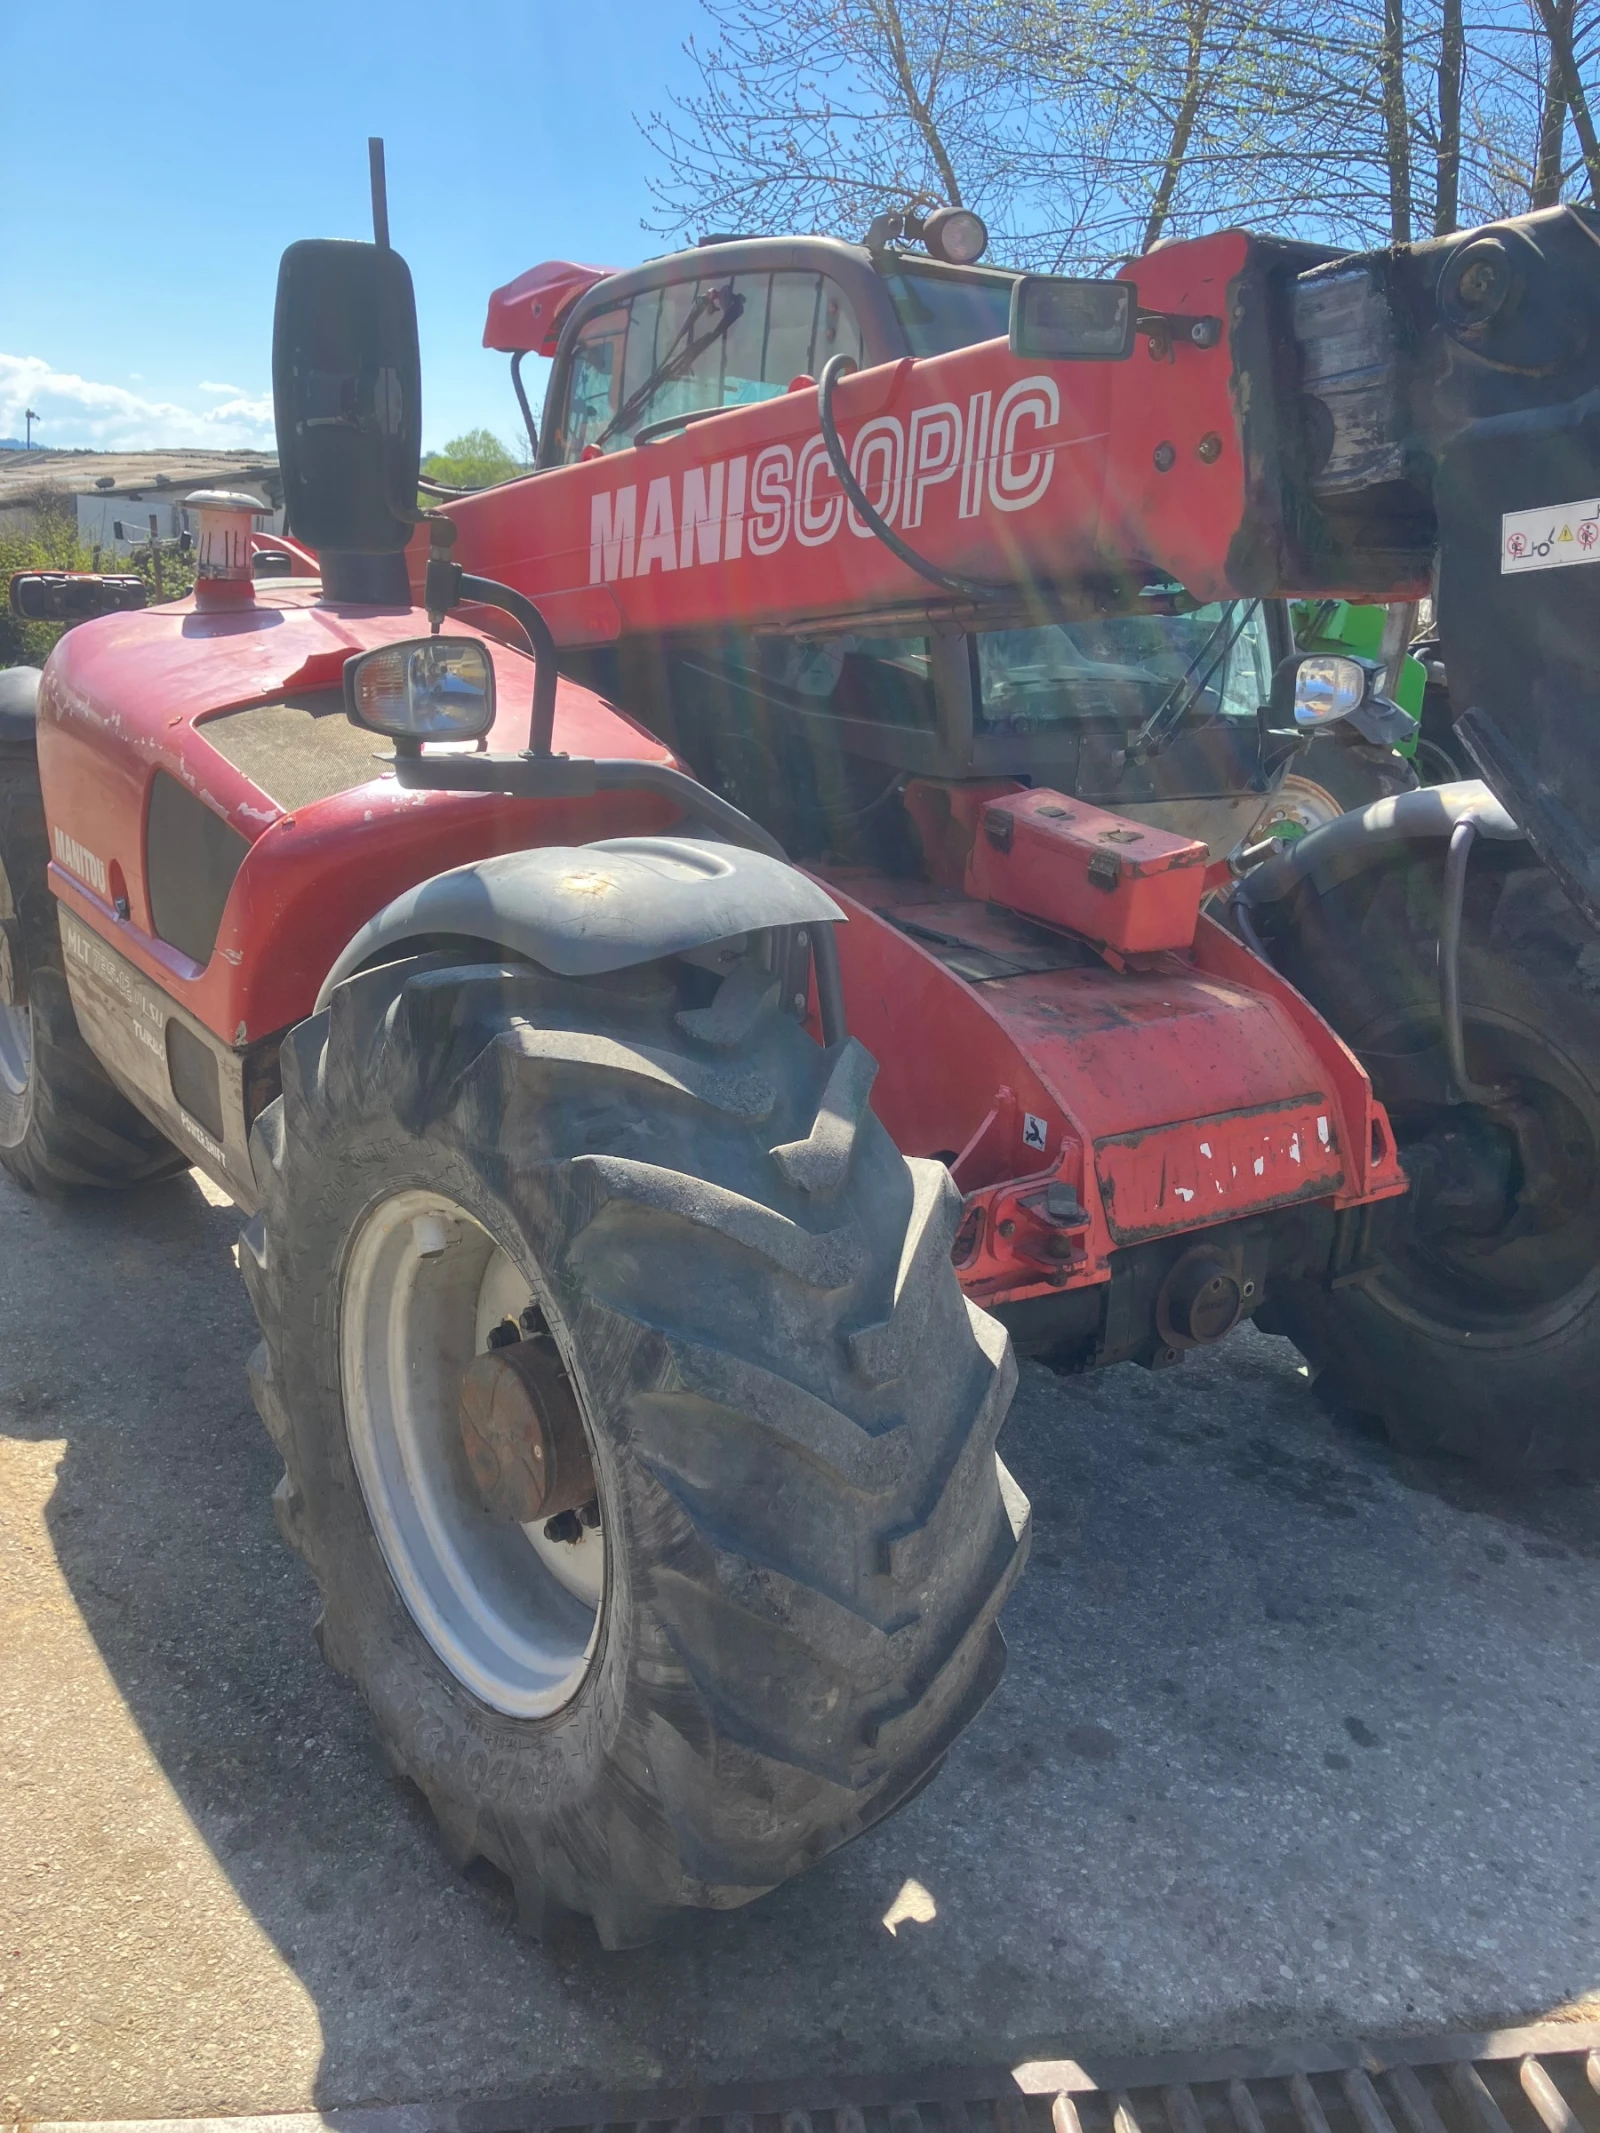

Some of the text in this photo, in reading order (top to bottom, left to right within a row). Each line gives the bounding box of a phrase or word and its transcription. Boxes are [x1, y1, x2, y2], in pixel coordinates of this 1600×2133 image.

[589, 375, 1060, 585] MANISCOPIC
[54, 825, 106, 894] MANITOU
[67, 926, 91, 964] MLT
